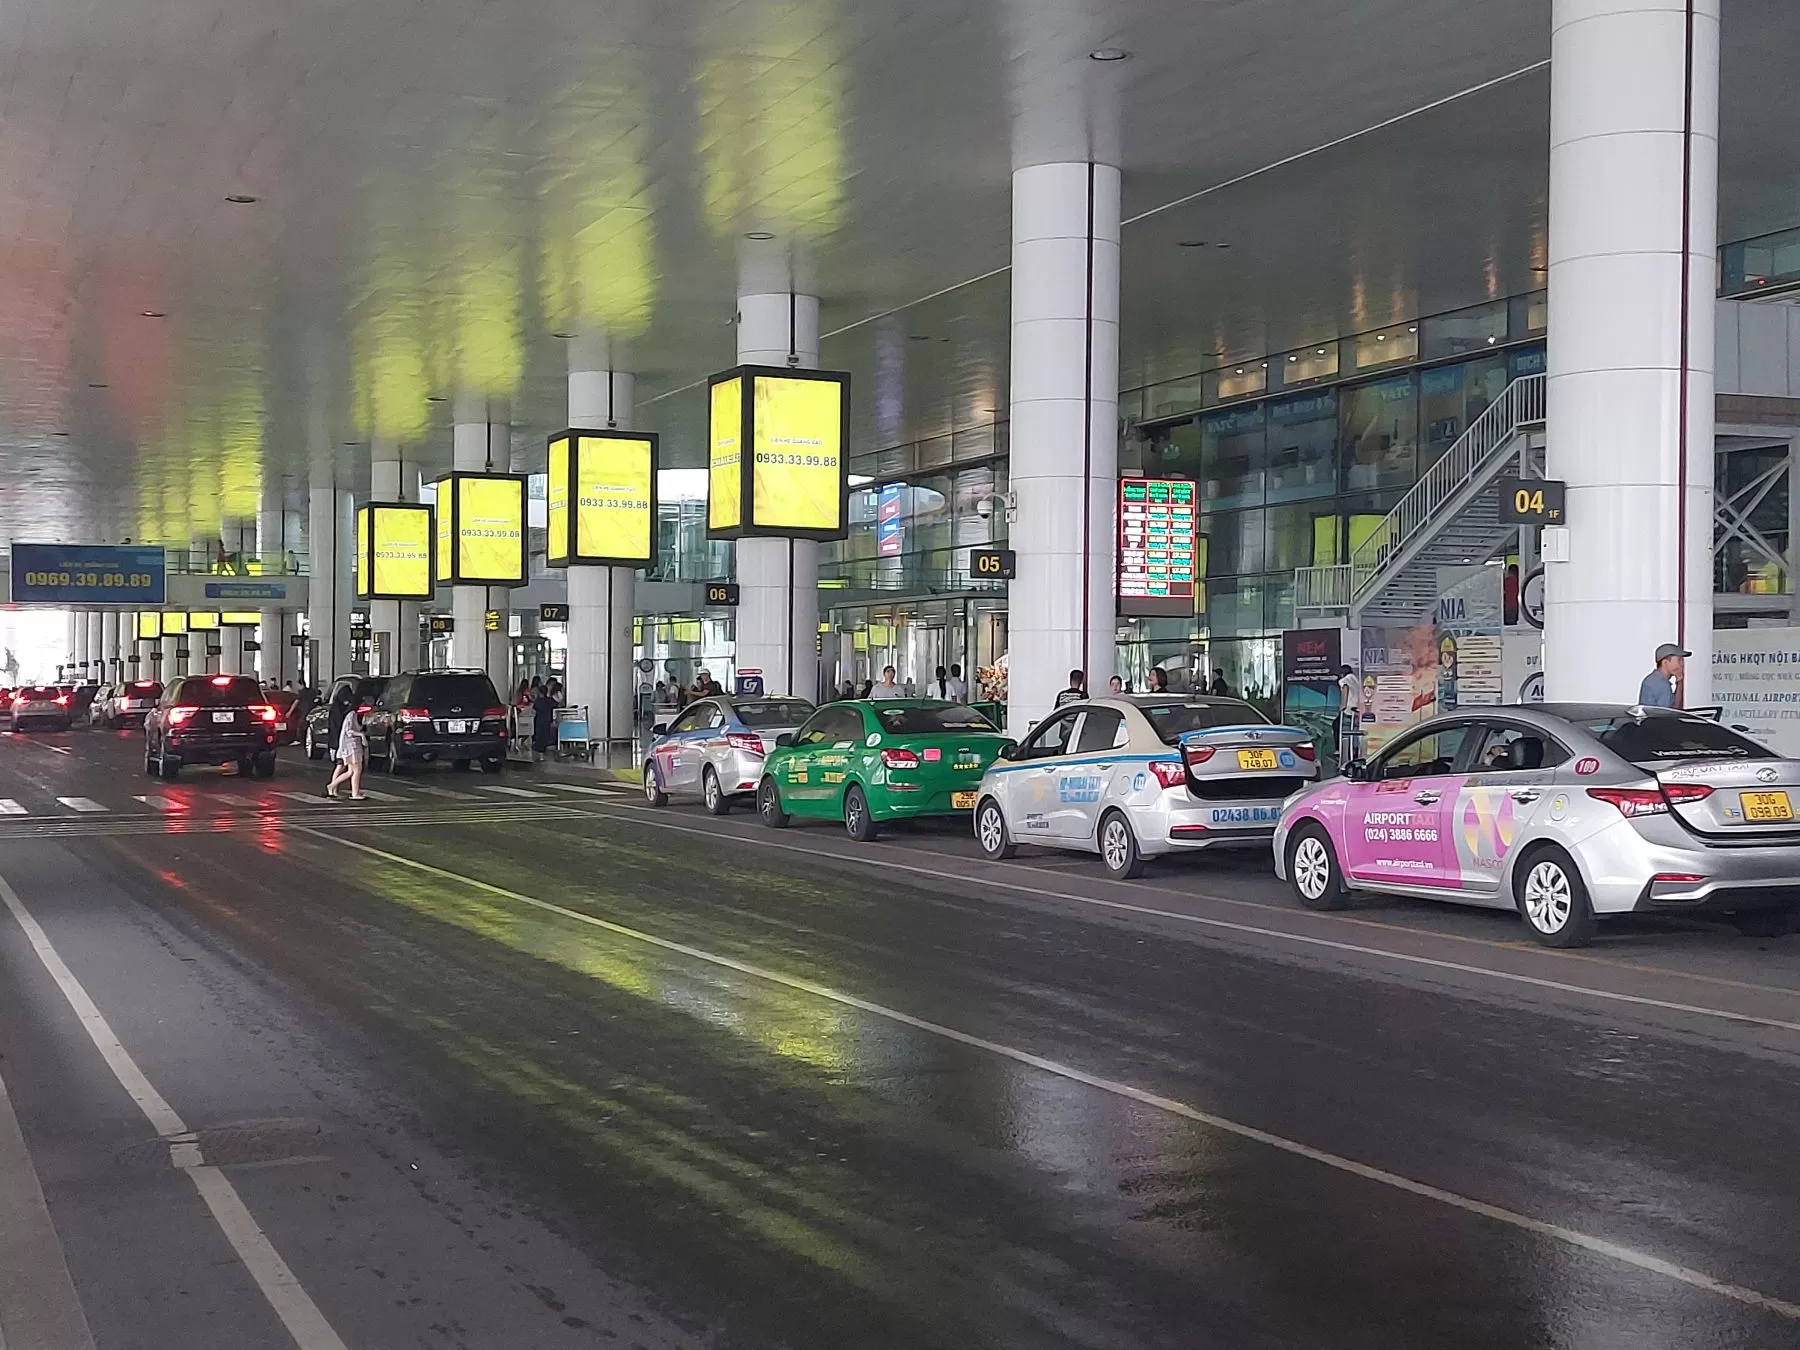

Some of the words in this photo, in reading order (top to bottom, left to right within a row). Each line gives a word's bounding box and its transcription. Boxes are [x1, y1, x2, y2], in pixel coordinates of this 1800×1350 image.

[756, 452, 837, 467] 0933.33.99.88
[580, 497, 648, 510] 0933.33.99.88
[1515, 489, 1544, 514] 04
[1548, 509, 1560, 519] 1F
[978, 556, 1000, 573] 05
[709, 587, 727, 601] 06
[544, 607, 559, 619] 07
[1440, 597, 1466, 620] NIA
[1364, 648, 1386, 664] NIA
[1739, 652, 1767, 666] HKQT
[1768, 649, 1789, 667] NỘI
[1754, 793, 1777, 805] 30G
[1365, 828, 1388, 844] (024)
[1389, 828, 1413, 841] 3886
[1413, 828, 1439, 842] 6666
